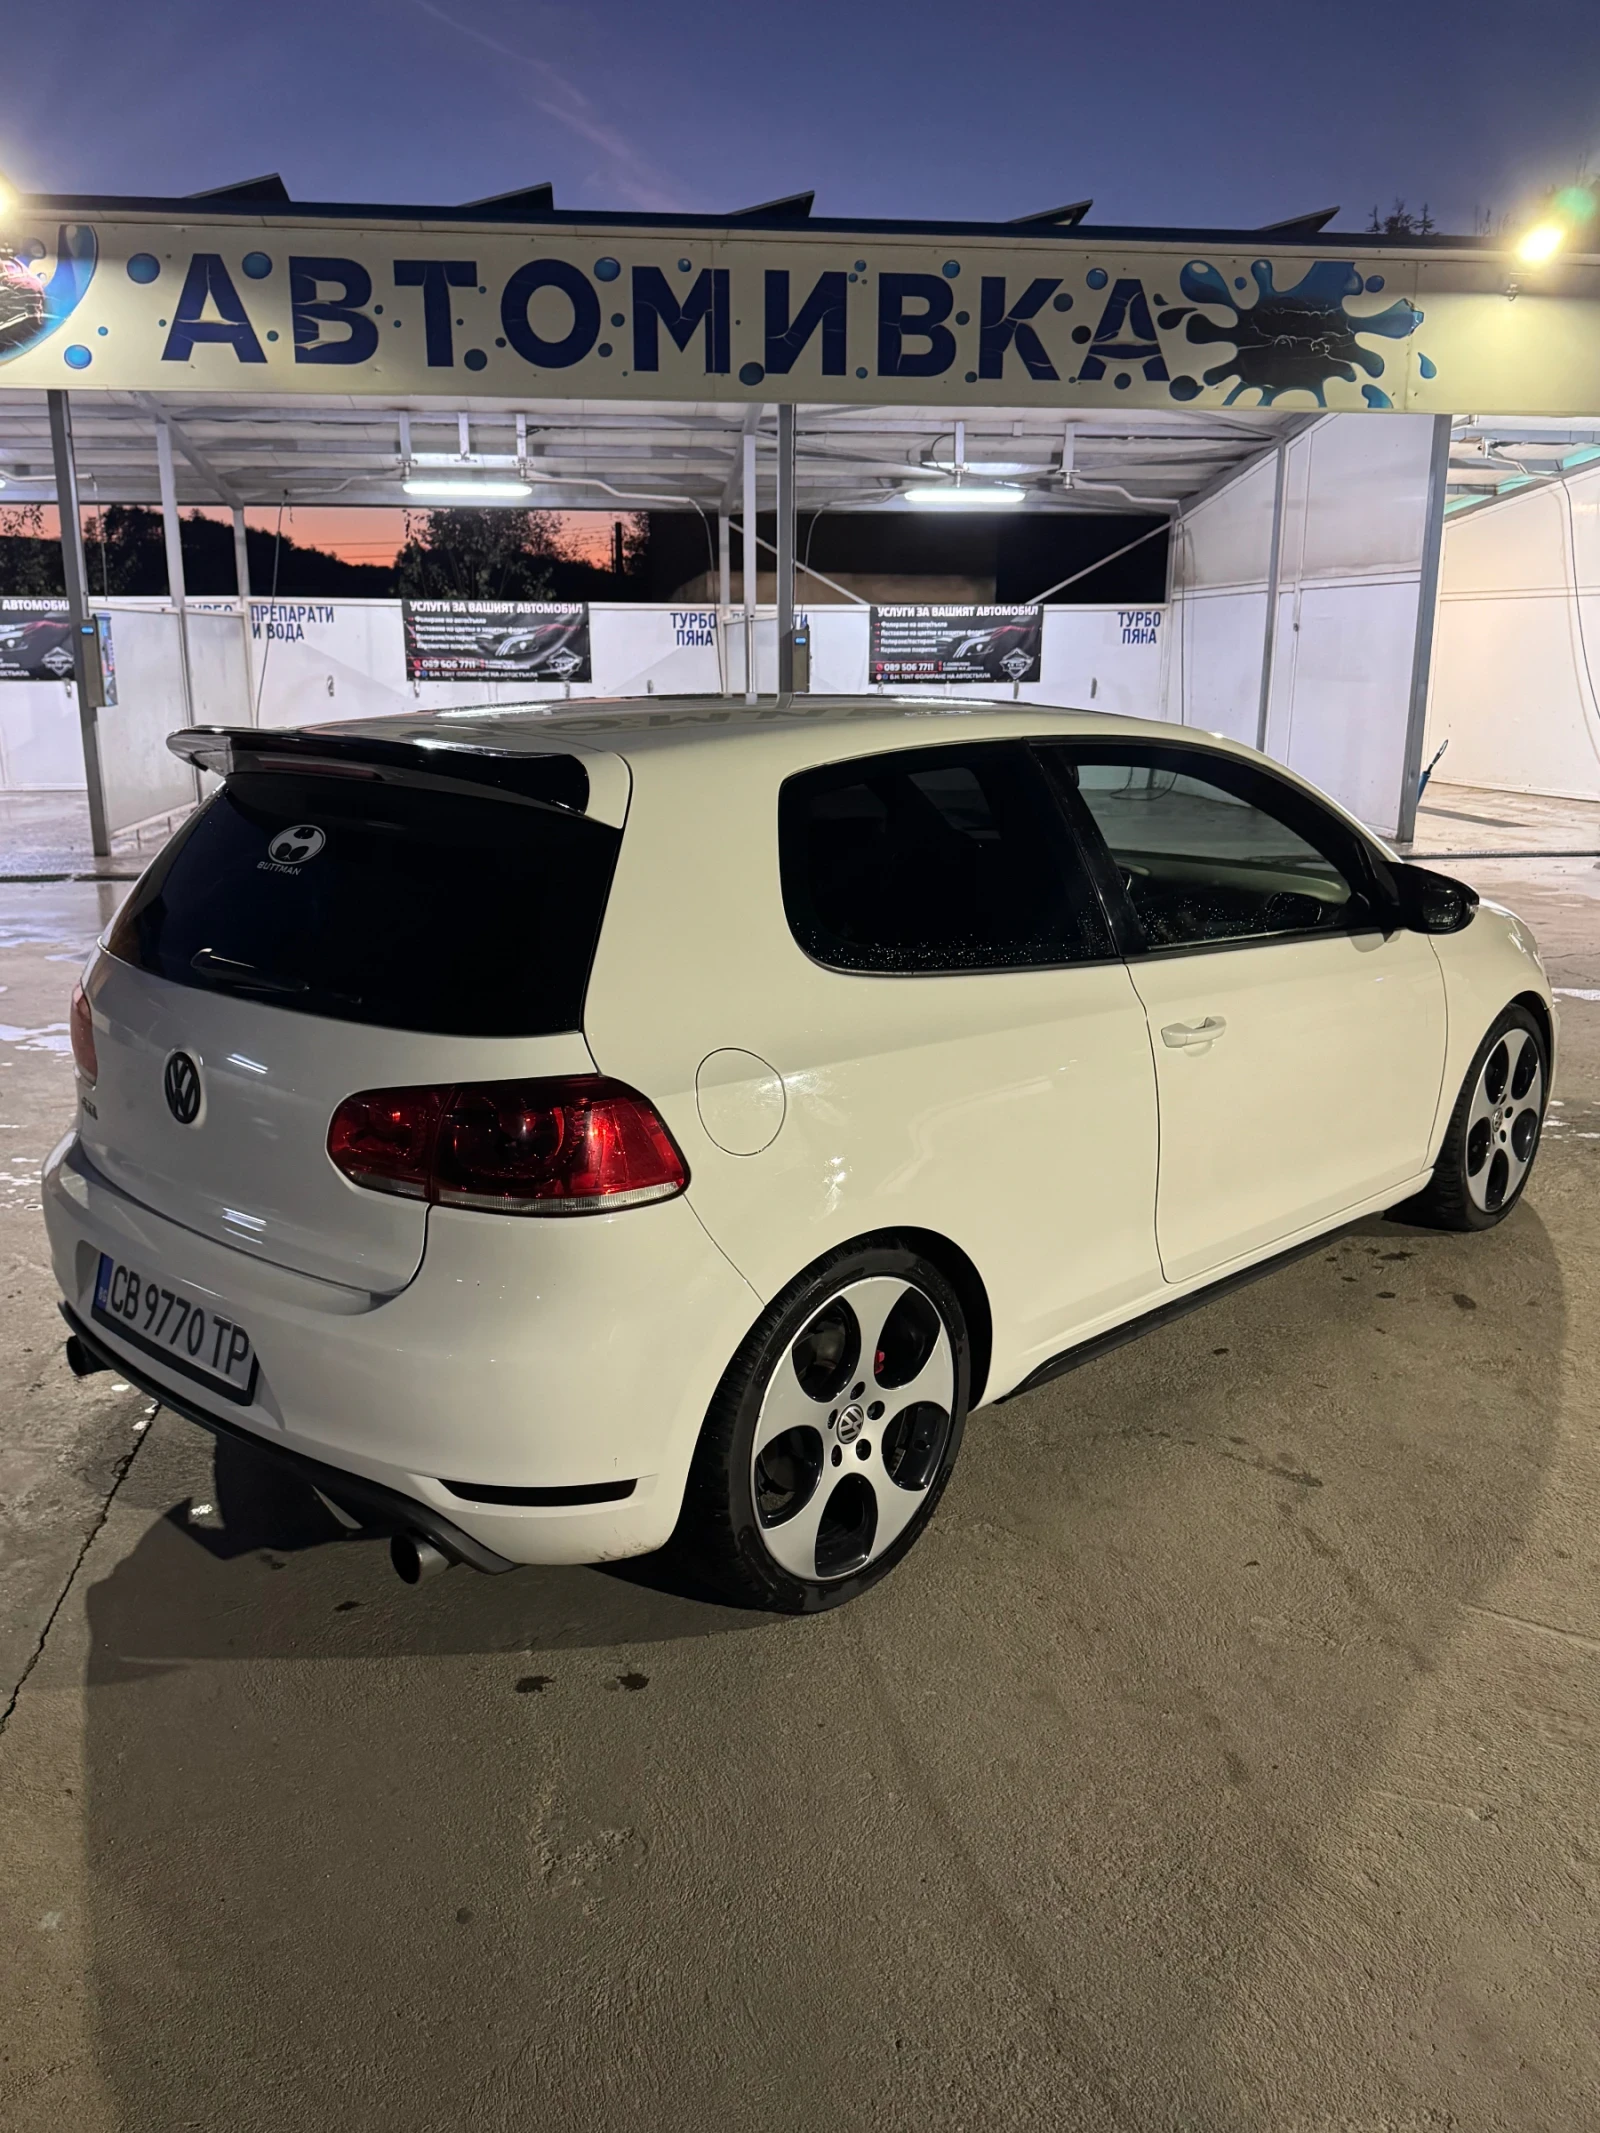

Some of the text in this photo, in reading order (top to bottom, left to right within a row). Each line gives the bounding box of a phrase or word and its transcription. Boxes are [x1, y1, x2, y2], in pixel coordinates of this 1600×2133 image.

[161, 253, 1170, 383] АВТОМИВКА
[250, 605, 335, 623] ПРЕПАРАТИ
[410, 602, 450, 612] УСЛУГИ
[453, 603, 467, 612] ЗА
[517, 603, 583, 614] АВТОМОБИЛ
[878, 606, 1039, 617] УСЛУГИ ЗА ВАШИЯТ АВТОМОБИЛ
[670, 612, 717, 629] ТУРБО
[1117, 611, 1162, 627] ТУРБО
[252, 623, 305, 643] И ВОДА
[676, 629, 714, 647] ПЯНА
[1122, 628, 1157, 644] ПЯНА
[883, 663, 900, 671] 089
[901, 663, 917, 671] 506
[918, 663, 934, 671] 7711
[256, 861, 302, 875] BUTTMAN
[111, 1264, 252, 1375] CB 9770 TP
